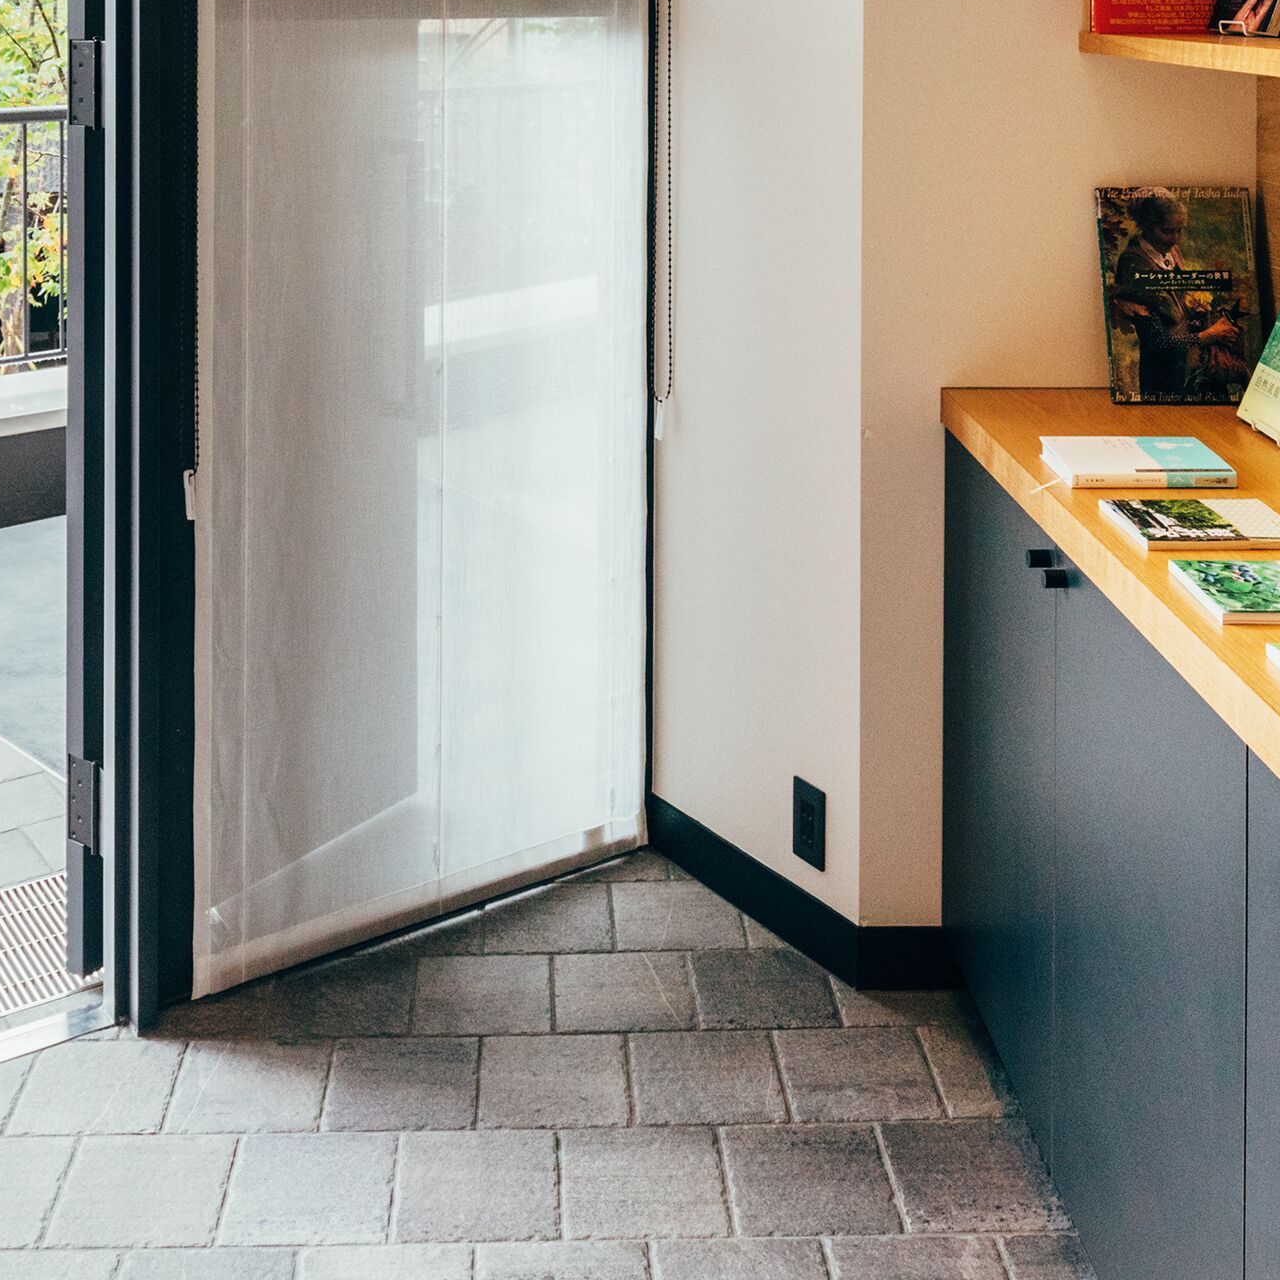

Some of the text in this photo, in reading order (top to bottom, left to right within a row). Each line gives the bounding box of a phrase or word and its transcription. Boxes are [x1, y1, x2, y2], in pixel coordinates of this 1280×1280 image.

[1120, 188, 1153, 199] Private
[1181, 188, 1191, 200] of
[1193, 188, 1220, 198] Tasha
[1223, 187, 1249, 198] Tudor
[1116, 391, 1128, 402] by
[1129, 391, 1157, 402] Tasha
